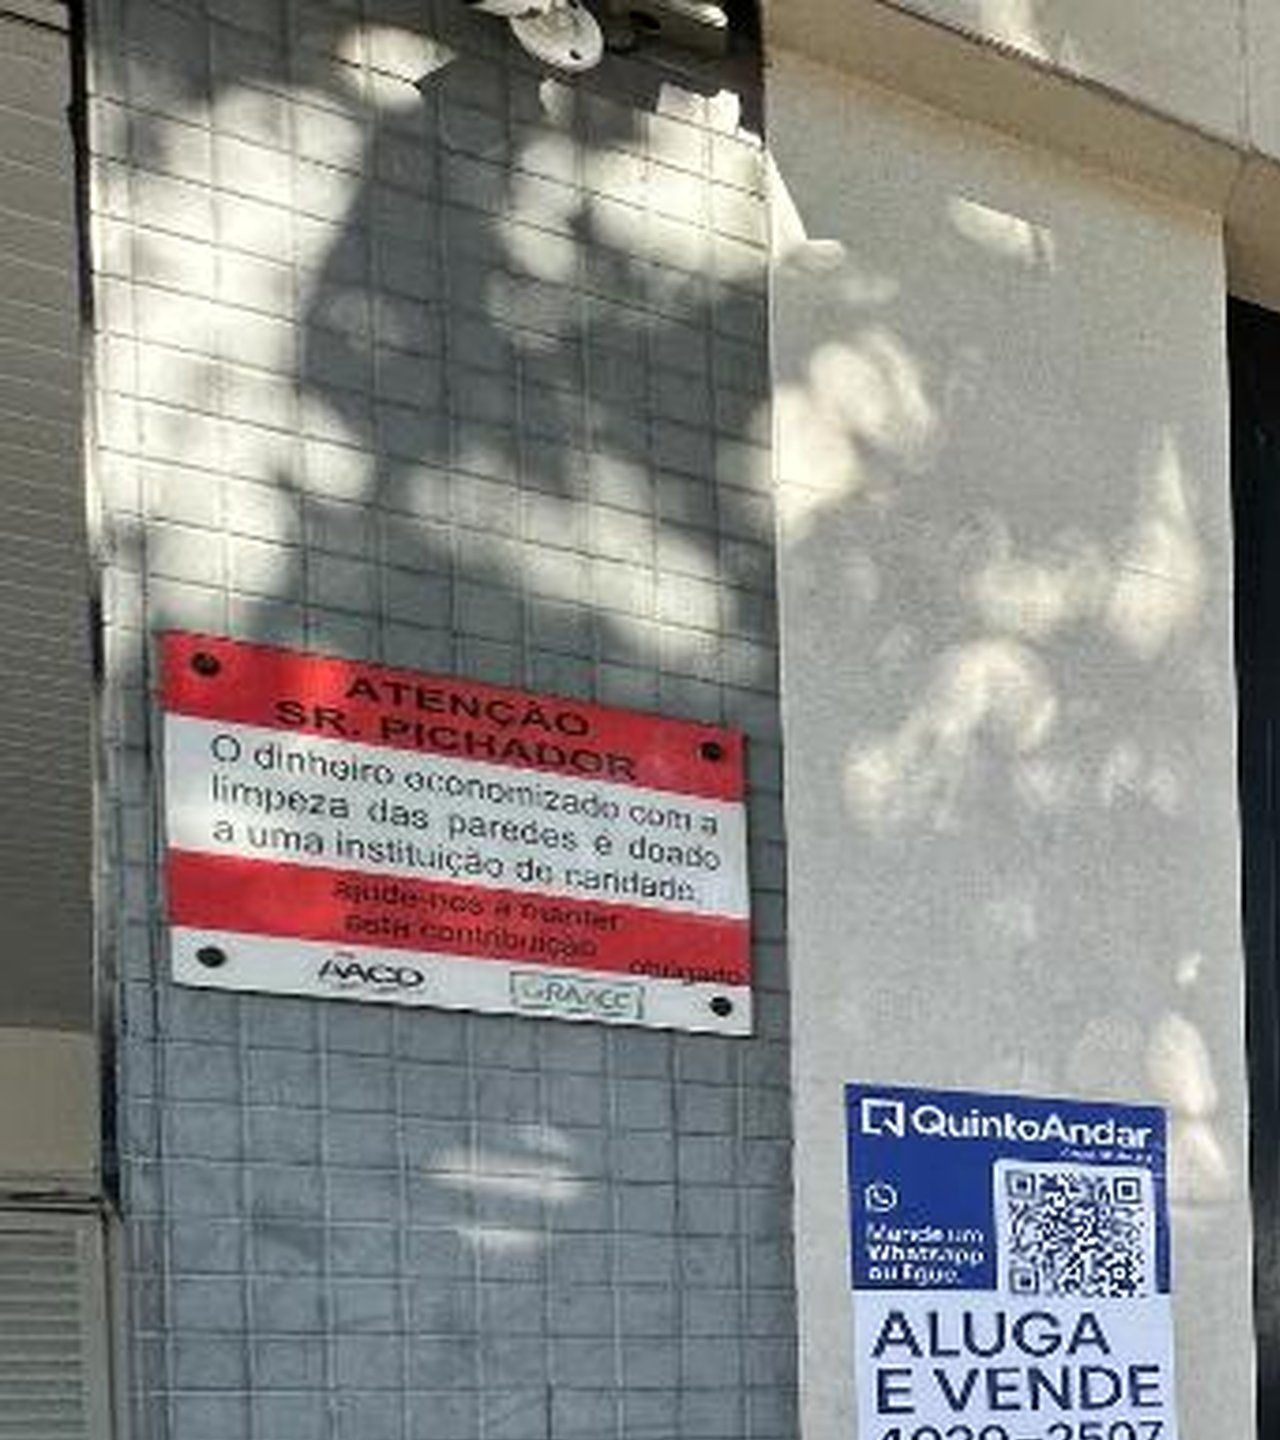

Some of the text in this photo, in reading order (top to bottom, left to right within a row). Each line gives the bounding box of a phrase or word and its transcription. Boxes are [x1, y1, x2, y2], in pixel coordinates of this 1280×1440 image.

[345, 677, 590, 736] ATENÇÃO
[274, 699, 637, 782] SR. PICHADOR
[210, 733, 718, 836] O dinheiro economizado com a
[211, 773, 351, 819] limpeza
[367, 798, 429, 830] das
[448, 812, 579, 852] paredes
[629, 835, 721, 871] doado
[212, 820, 234, 842] a
[248, 824, 323, 855] uma
[336, 830, 504, 879] instituição
[911, 1104, 1152, 1148] QuintoAndar
[871, 1310, 1111, 1358] ALUGA
[876, 1364, 1164, 1415] E VENDE
